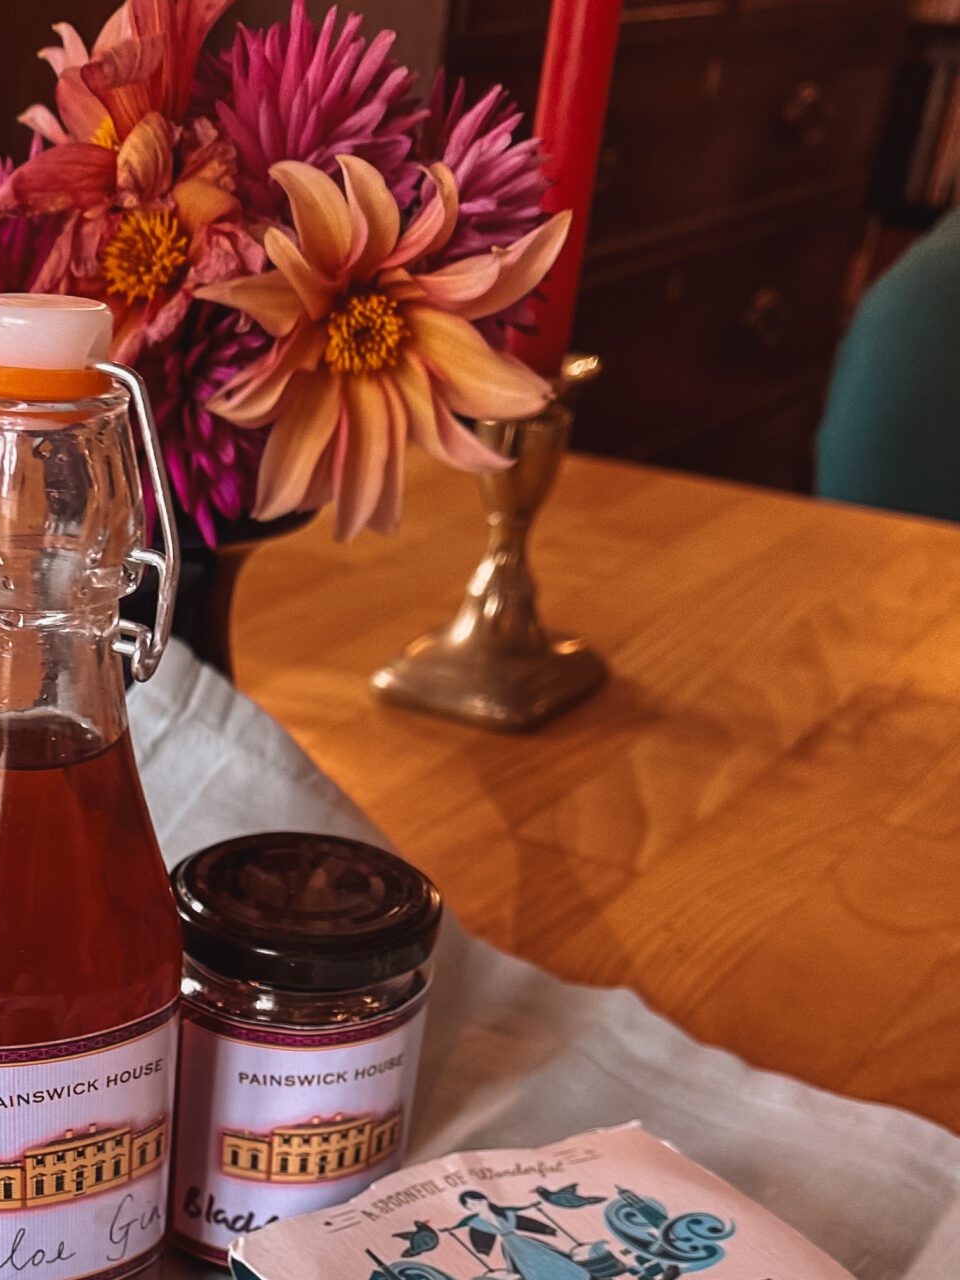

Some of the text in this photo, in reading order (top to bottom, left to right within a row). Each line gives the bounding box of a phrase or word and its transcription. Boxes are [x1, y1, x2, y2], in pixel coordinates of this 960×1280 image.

[106, 1058, 164, 1088] HOUSE
[237, 1054, 404, 1087] PAINSWICK HOUSE
[372, 1180, 445, 1216] SPOONFUL
[443, 1172, 470, 1189] OF
[468, 1161, 565, 1181] Wonderful
[106, 1193, 162, 1262] Gin
